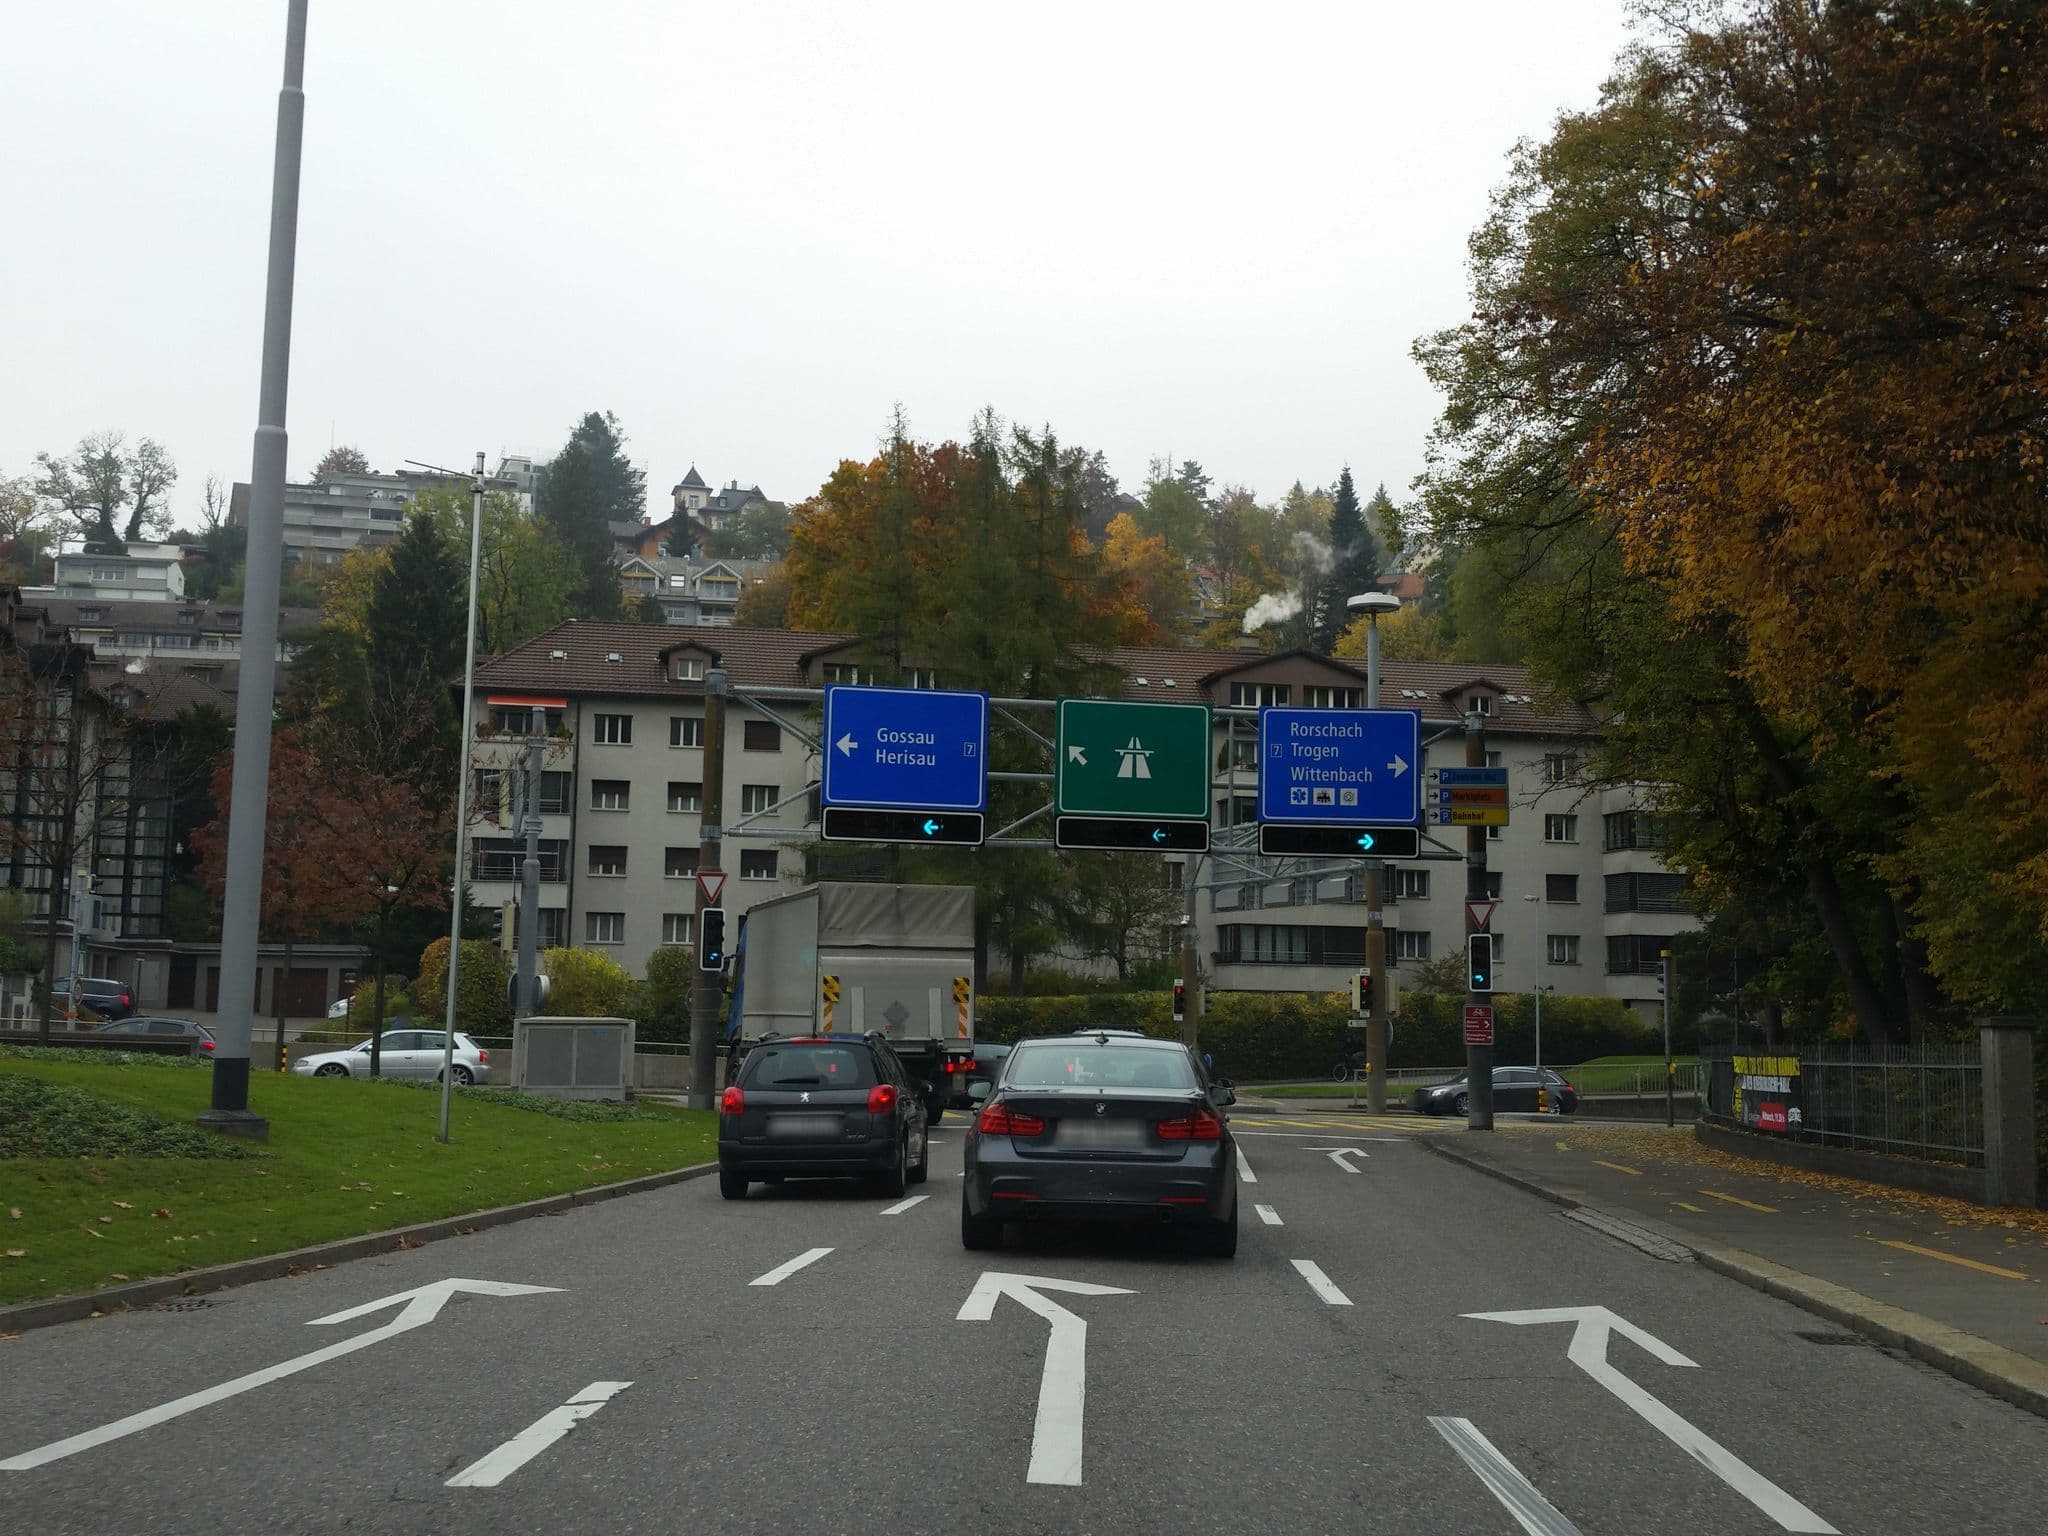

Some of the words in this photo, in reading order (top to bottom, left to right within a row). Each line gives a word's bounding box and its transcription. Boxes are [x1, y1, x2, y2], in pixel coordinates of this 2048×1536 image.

[877, 728, 935, 744] Gossau
[1290, 721, 1363, 738] Rorschach
[876, 749, 936, 766] Herisau
[967, 744, 973, 755] 7
[1273, 745, 1280, 756] 7
[1290, 742, 1340, 761] Trogen
[1290, 766, 1373, 783] Wittenbach
[1442, 791, 1449, 801] P
[1452, 811, 1485, 821] Bahnhof
